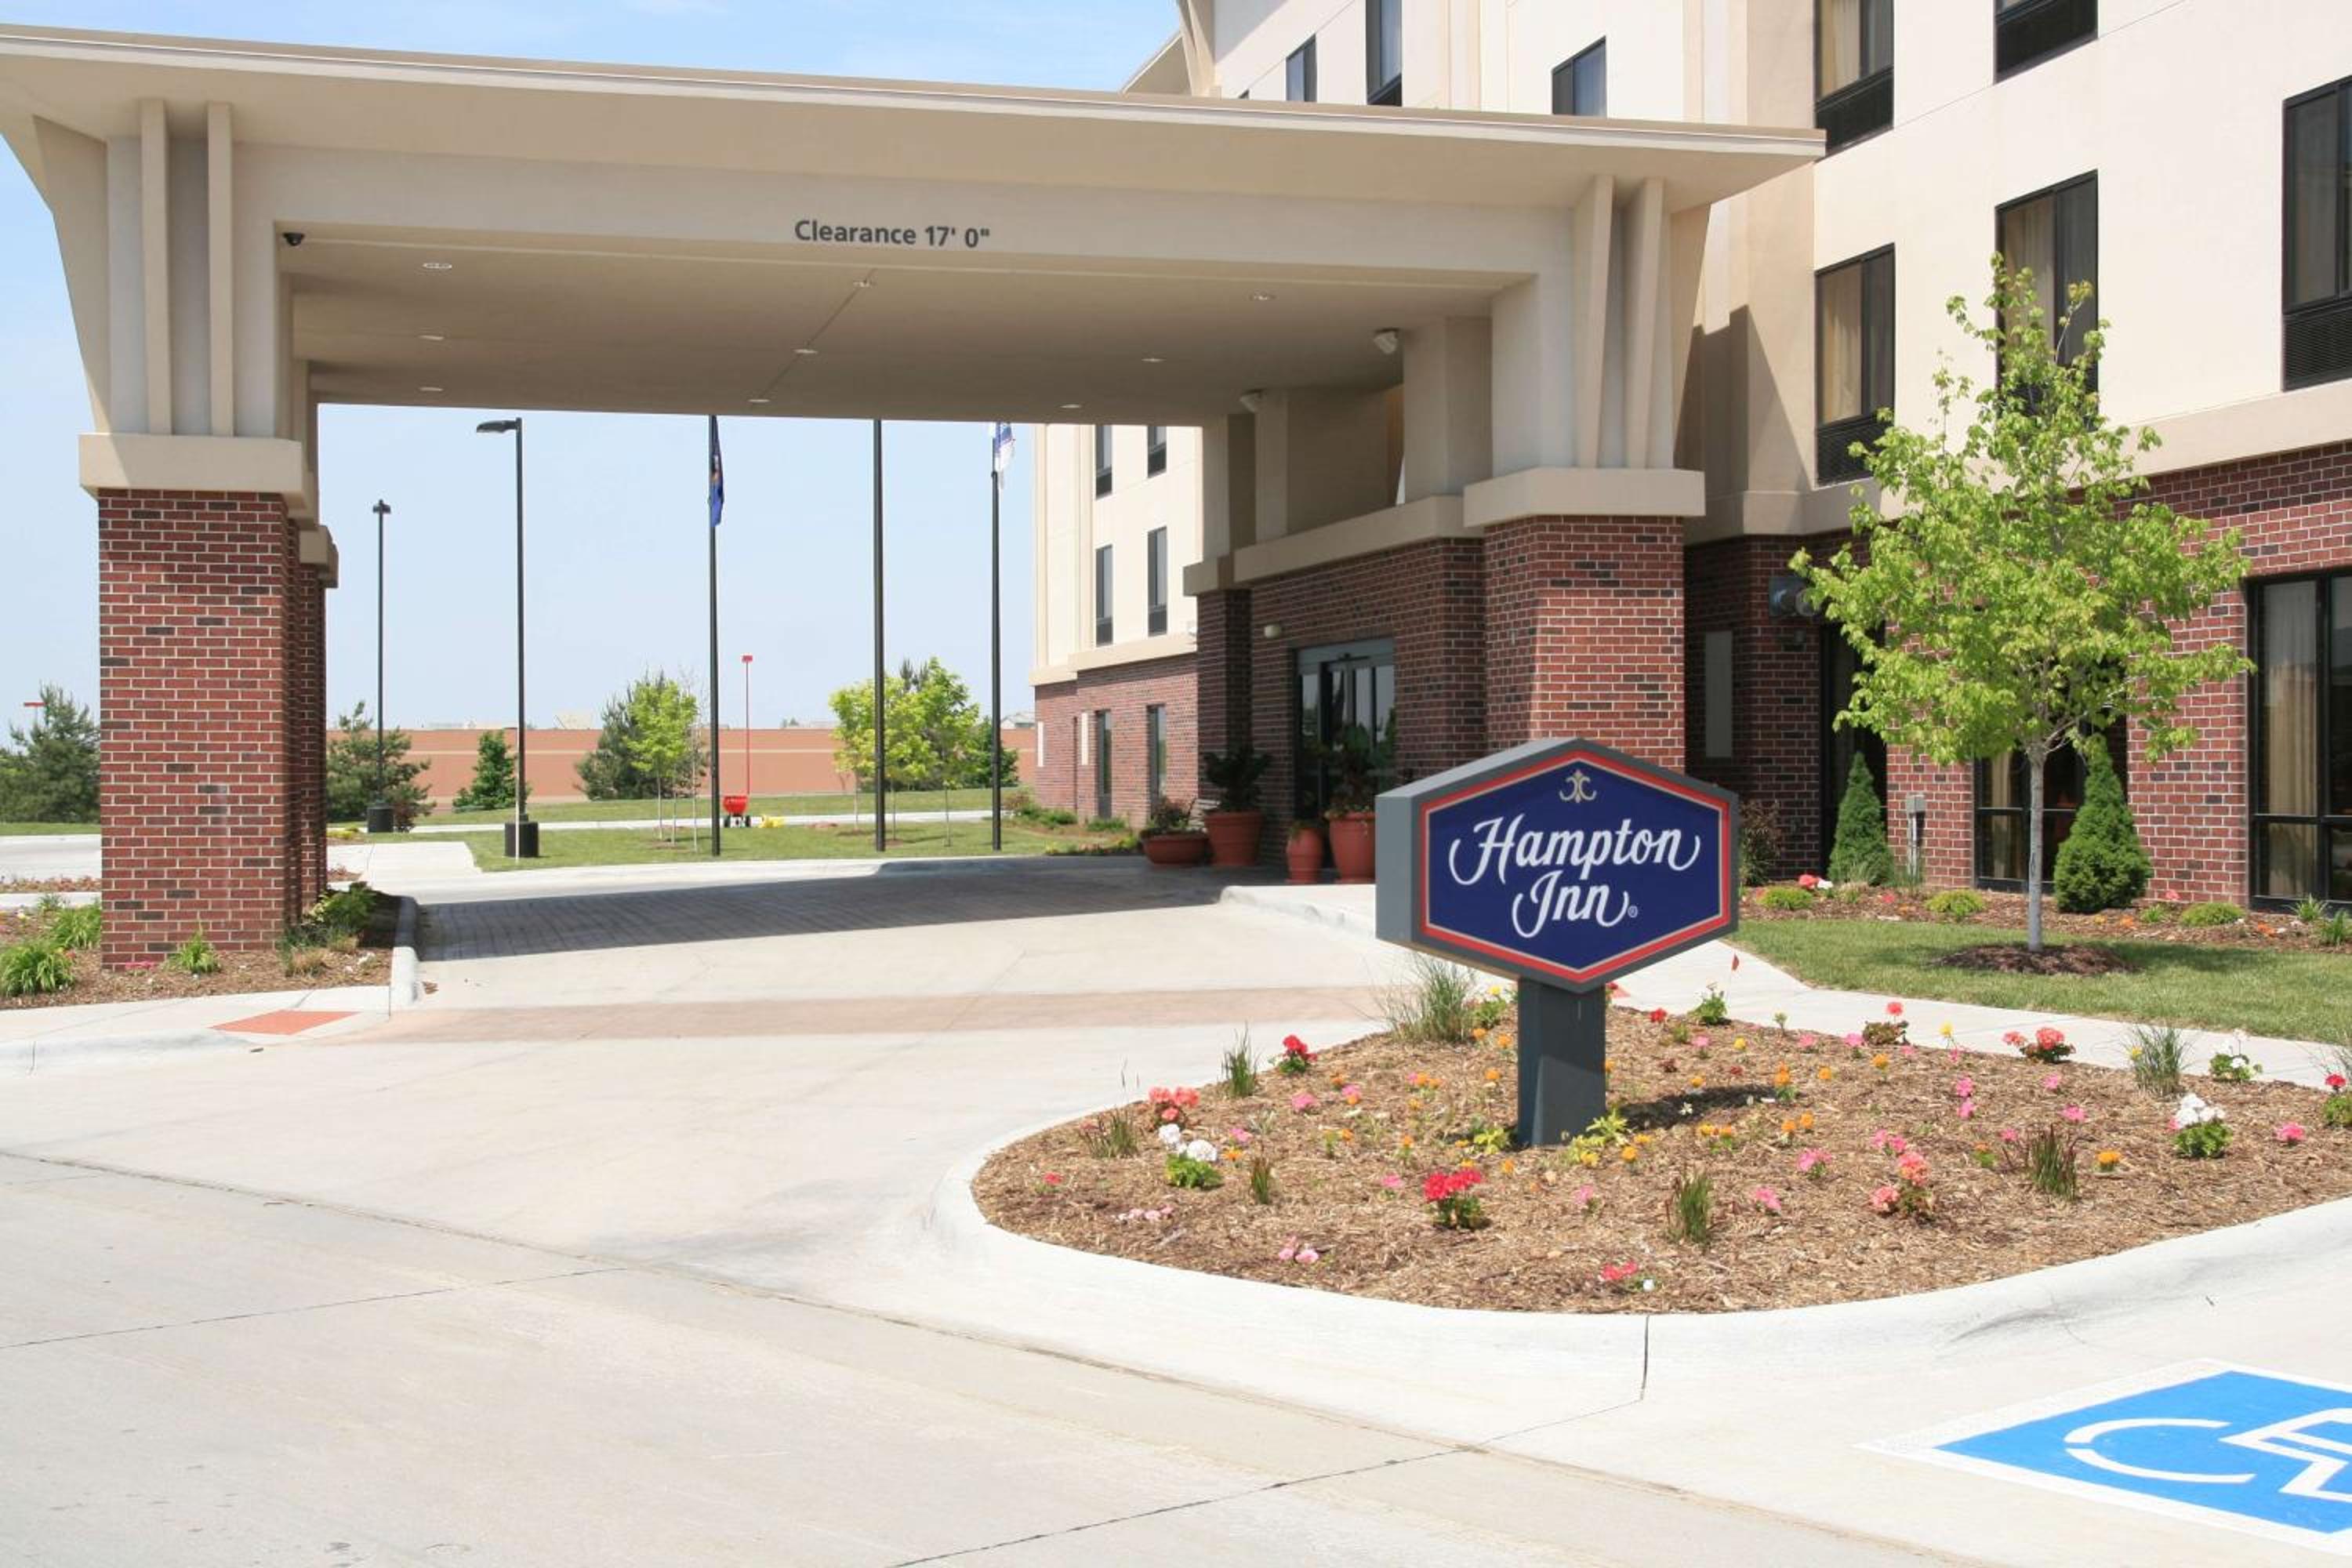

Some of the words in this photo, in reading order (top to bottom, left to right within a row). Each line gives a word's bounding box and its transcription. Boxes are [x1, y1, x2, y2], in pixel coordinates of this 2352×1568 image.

[794, 220, 916, 245] Clearance
[925, 226, 956, 246] 17'
[964, 228, 990, 248] 0"
[1449, 814, 1700, 886] Hampton
